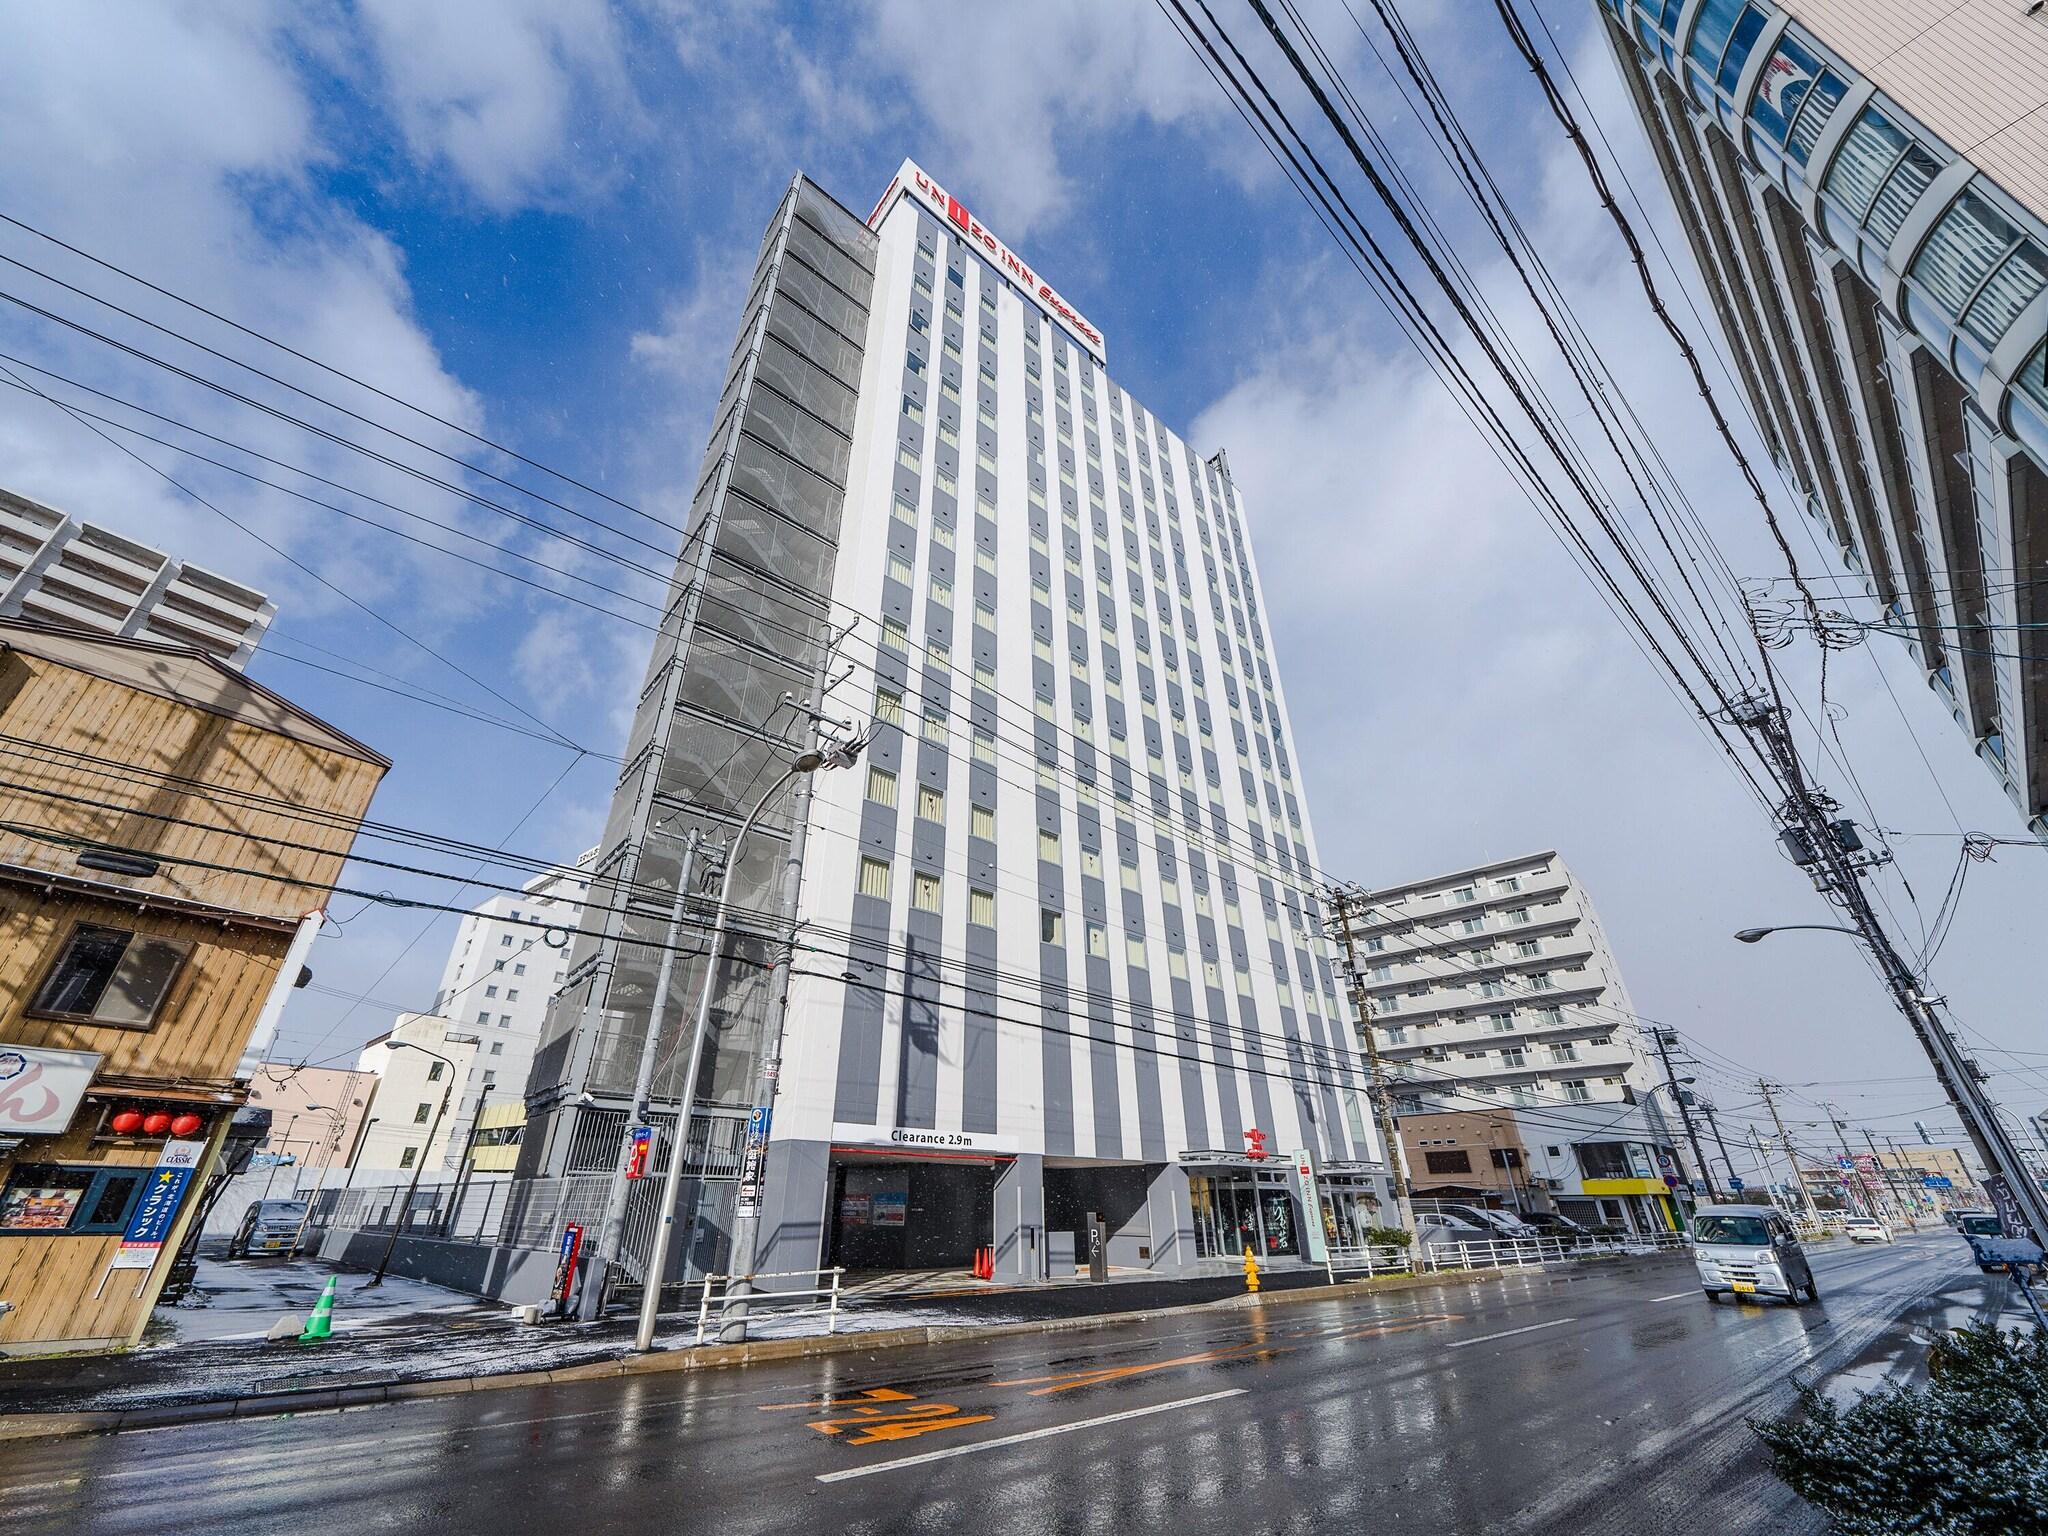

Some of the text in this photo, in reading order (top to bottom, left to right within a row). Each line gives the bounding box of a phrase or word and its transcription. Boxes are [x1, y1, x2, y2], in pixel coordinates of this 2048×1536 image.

[915, 171, 1101, 345] UNIZO INN Express
[891, 1130, 945, 1144] Clearance
[166, 1156, 192, 1164] CLASSIC
[134, 1184, 168, 1238] クラシック
